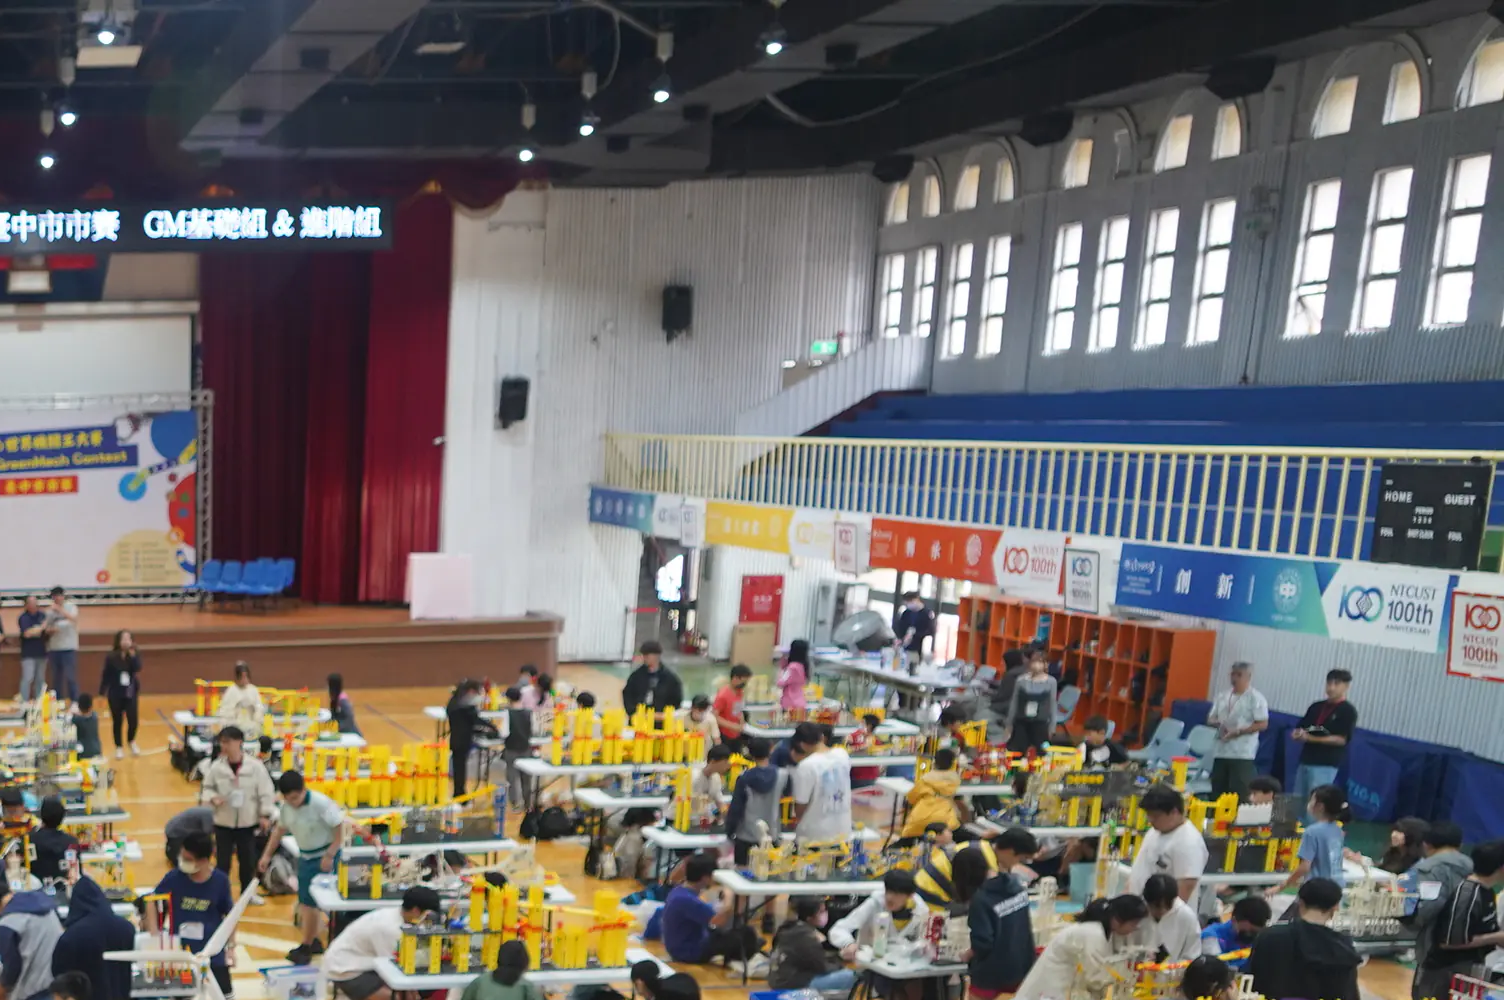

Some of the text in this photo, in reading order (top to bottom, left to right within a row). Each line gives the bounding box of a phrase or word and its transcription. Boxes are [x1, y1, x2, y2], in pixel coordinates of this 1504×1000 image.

[272, 209, 295, 238] &
[1384, 491, 1476, 505] HOME GUEST
[1390, 583, 1437, 600] NTCUST
[1387, 600, 1434, 625] 100th
[1462, 646, 1499, 663] 100th
